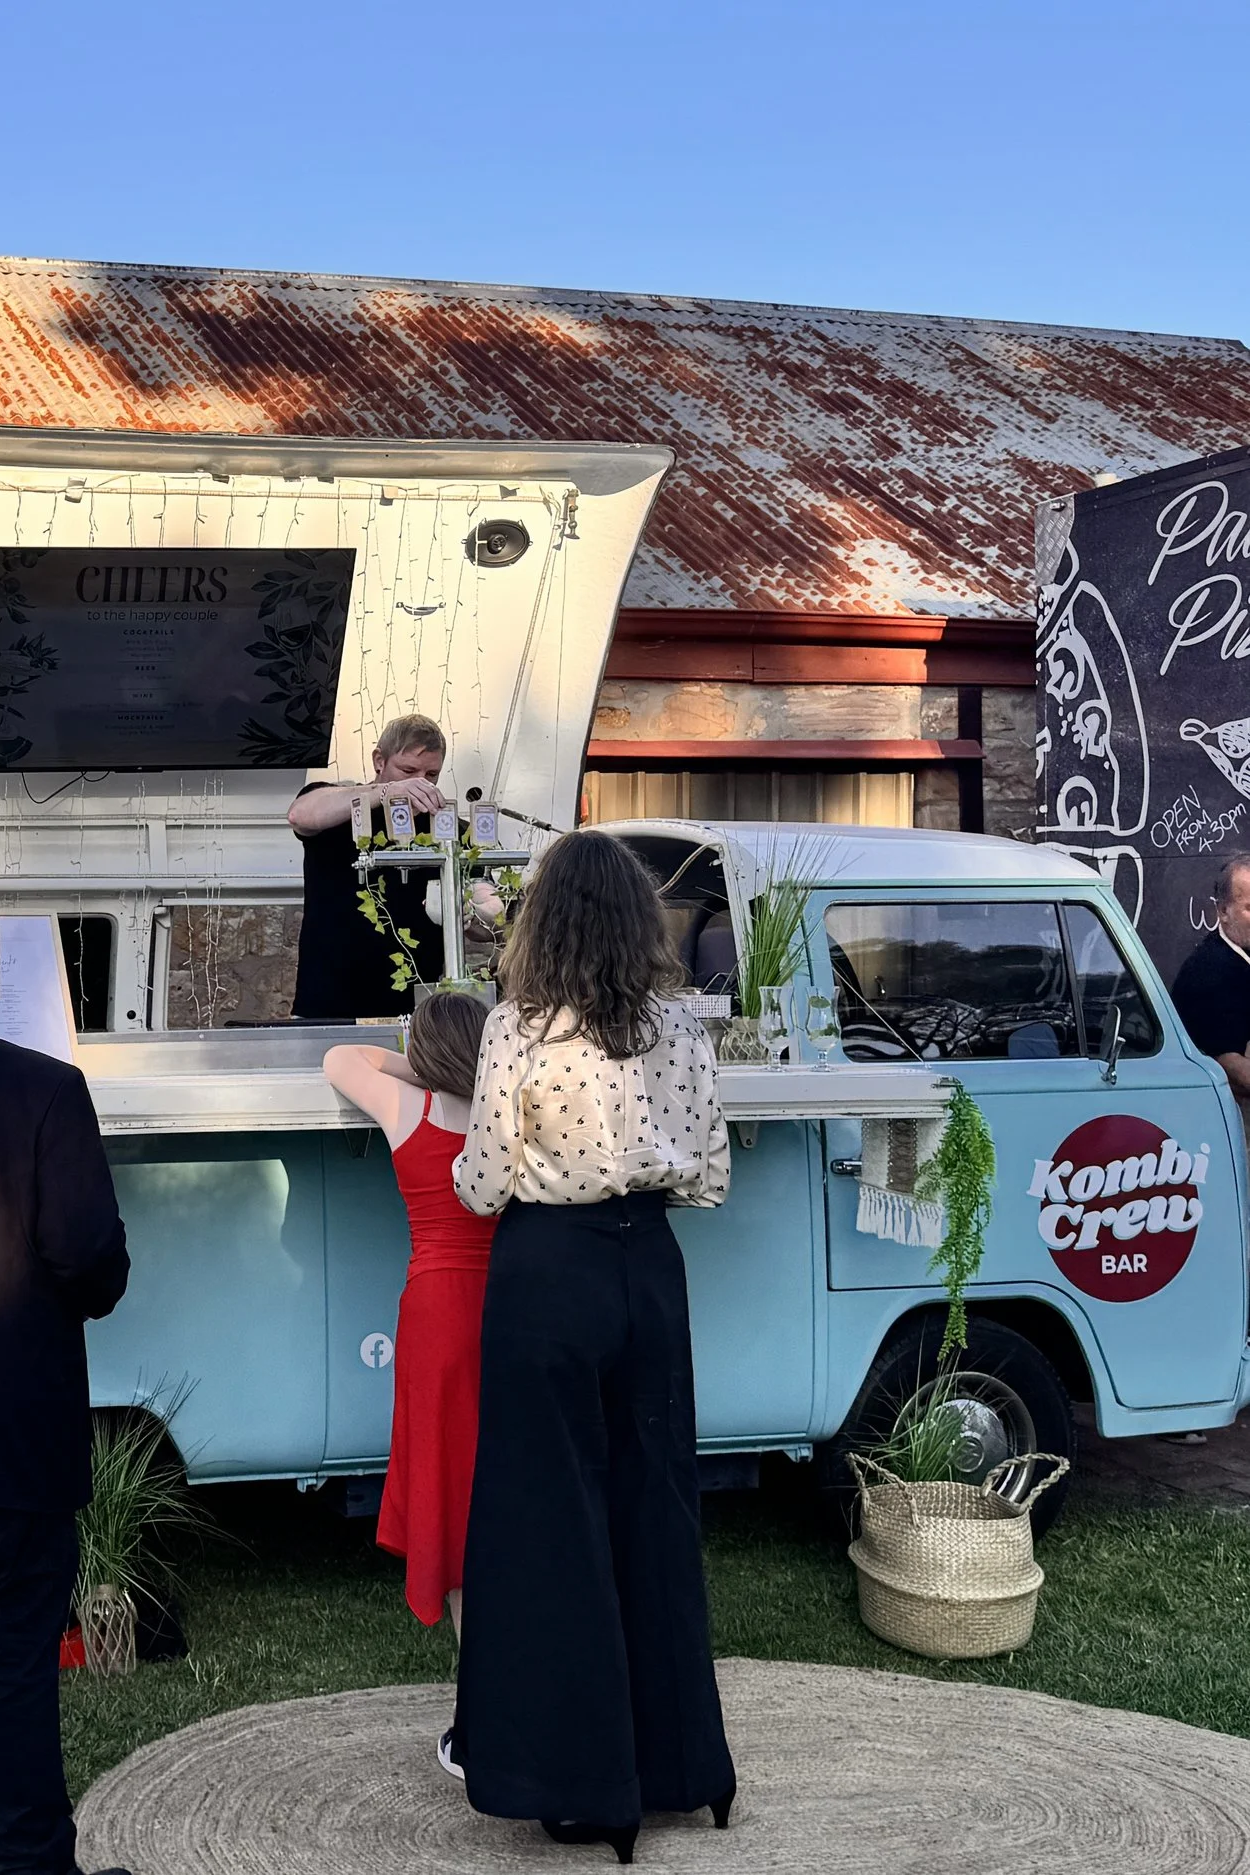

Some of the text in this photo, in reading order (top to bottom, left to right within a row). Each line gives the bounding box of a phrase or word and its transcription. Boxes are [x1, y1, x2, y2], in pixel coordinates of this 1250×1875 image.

[75, 566, 229, 604] CHEERS
[87, 608, 218, 624] to the happy couple
[1150, 785, 1201, 848] OPEN
[1175, 809, 1212, 854] FROM
[1026, 1138, 1211, 1204] Kombi
[1037, 1194, 1204, 1251] Crew
[1101, 1253, 1148, 1275] BAR
